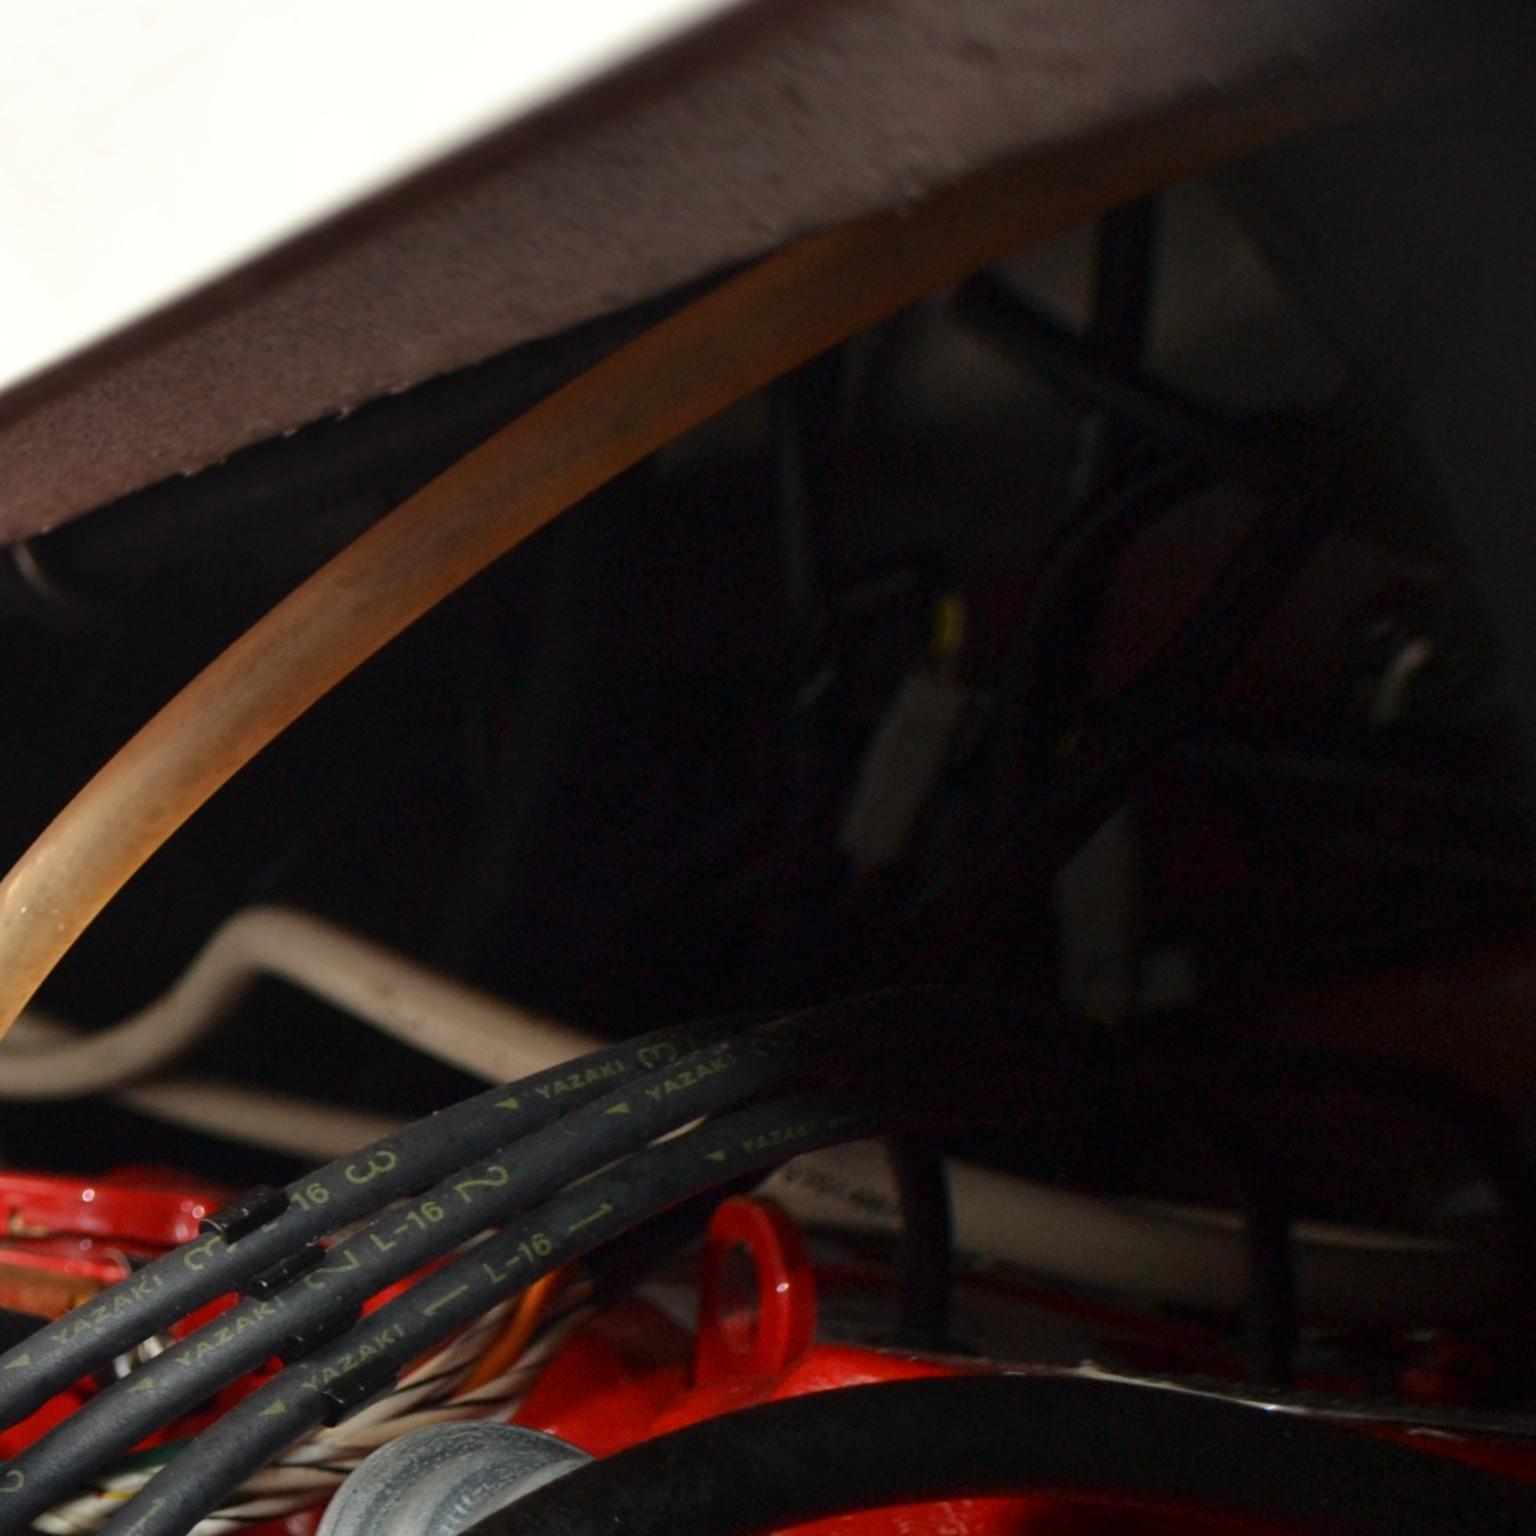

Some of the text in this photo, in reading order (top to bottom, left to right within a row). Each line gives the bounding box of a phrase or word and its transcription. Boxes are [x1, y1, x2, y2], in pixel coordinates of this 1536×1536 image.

[50, 1274, 164, 1345] YAZAKI
[344, 1150, 398, 1185] 3
[534, 1058, 626, 1099] YAZAKI
[175, 1297, 283, 1368] YAZAKI
[304, 1250, 360, 1290] 2
[369, 1201, 446, 1252] L-16
[453, 1165, 509, 1203] 2
[645, 1053, 736, 1101] YAZAKI
[303, 1323, 406, 1392] YAZAKI
[483, 1232, 553, 1285] L-16
